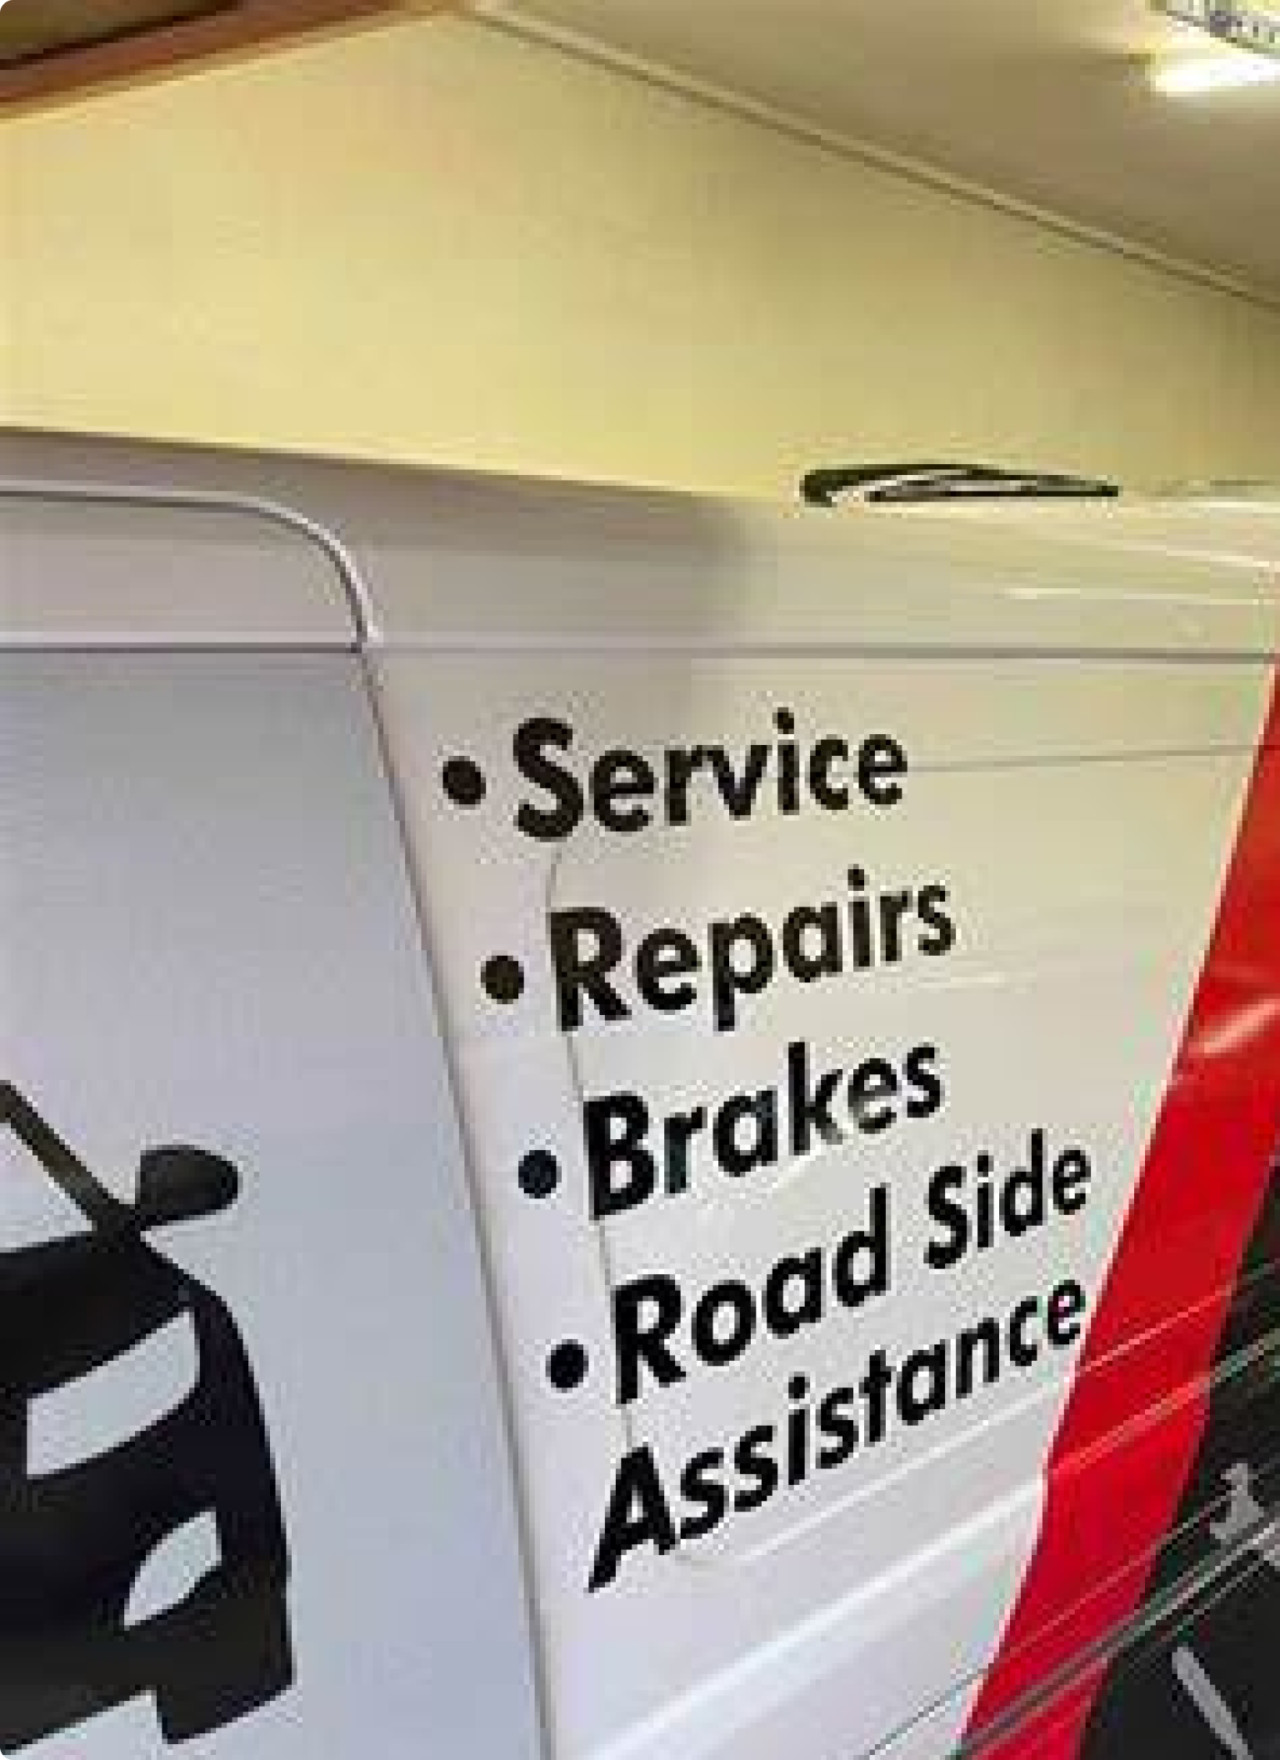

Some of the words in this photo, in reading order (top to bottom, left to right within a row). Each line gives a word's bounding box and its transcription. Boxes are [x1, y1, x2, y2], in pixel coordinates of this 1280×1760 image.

[512, 707, 908, 842] Service
[548, 865, 957, 1032] Repairs
[583, 1041, 942, 1220] Brakes
[614, 1186, 889, 1405] Road
[923, 1129, 1092, 1269] Side
[587, 1278, 1086, 1593] Assistance
